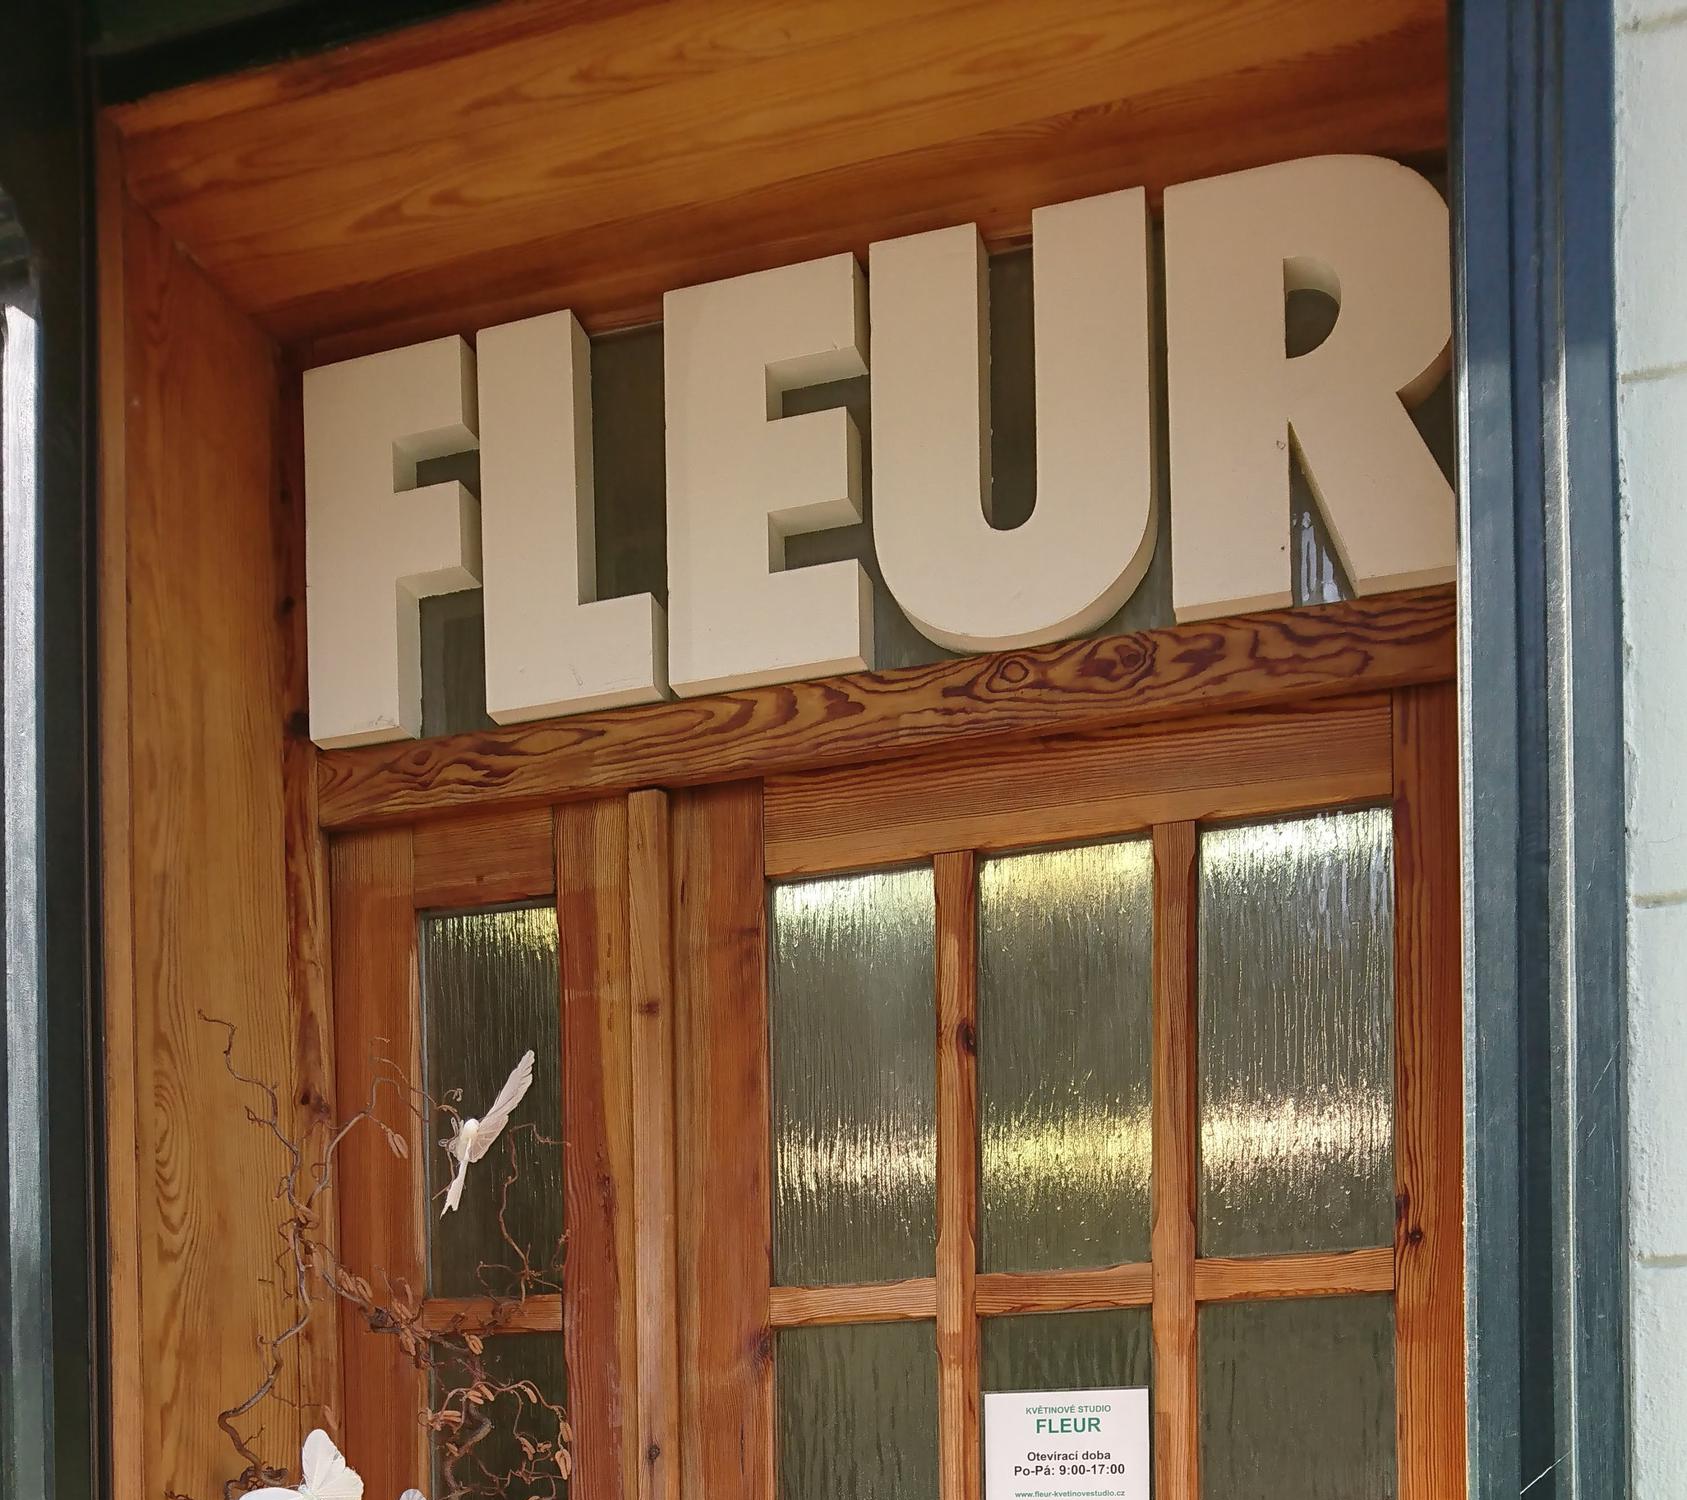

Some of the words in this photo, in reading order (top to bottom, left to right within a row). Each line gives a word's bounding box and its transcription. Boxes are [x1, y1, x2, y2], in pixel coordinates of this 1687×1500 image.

[302, 153, 1458, 751] FLEUR
[1025, 1405, 1076, 1415] KVĚTINOVÉ
[1078, 1405, 1112, 1413] STUDIO
[1036, 1417, 1101, 1434] FLEUR
[1027, 1451, 1078, 1461] Otevírací
[1081, 1450, 1111, 1460] doba
[1014, 1465, 1055, 1476] Po-Pá:
[1059, 1463, 1125, 1475] 9:00-17:00
[1015, 1490, 1125, 1498] www.fleur-kvetinovestudio.cz
